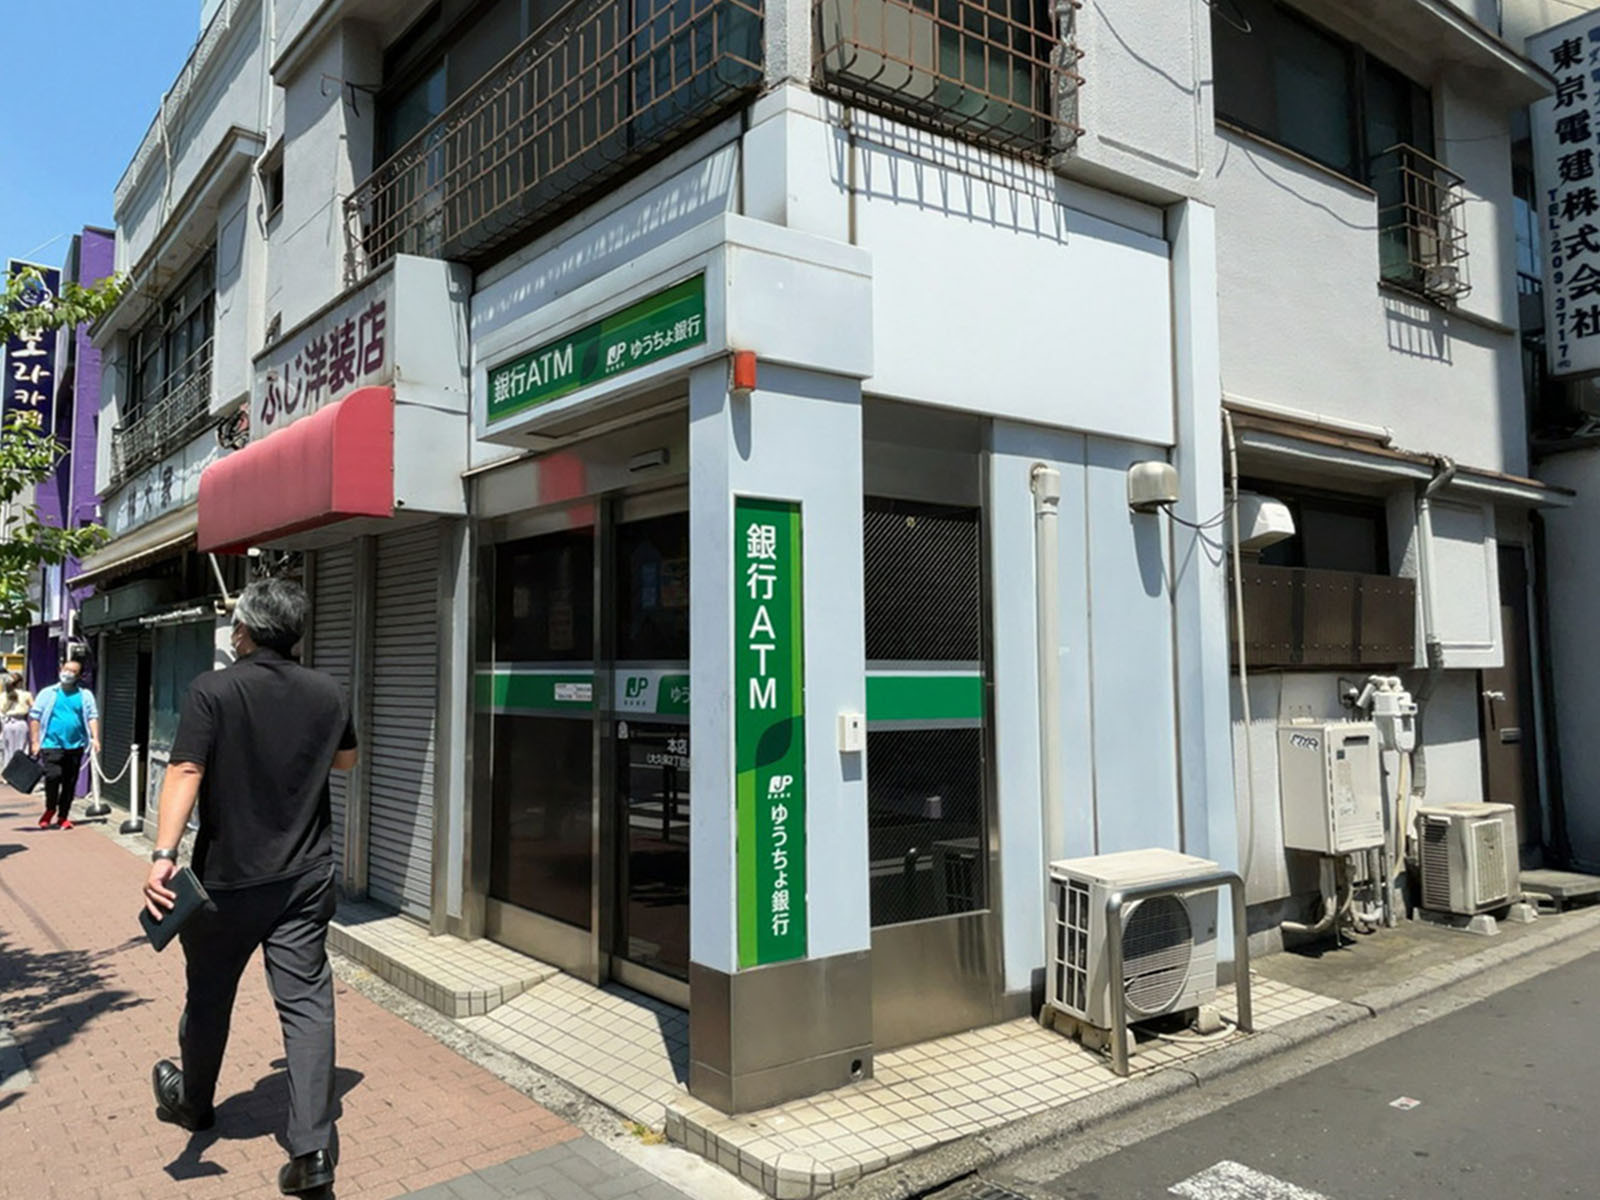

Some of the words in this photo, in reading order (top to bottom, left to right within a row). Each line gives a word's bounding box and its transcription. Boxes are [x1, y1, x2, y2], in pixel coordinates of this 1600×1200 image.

[261, 300, 386, 425] ふじ洋装店
[494, 343, 574, 404] 銀行ATM
[630, 314, 701, 360] ゆうちょ銀行
[746, 522, 777, 710] 銀行ATM
[771, 803, 790, 936] ゆうちょ銀行
